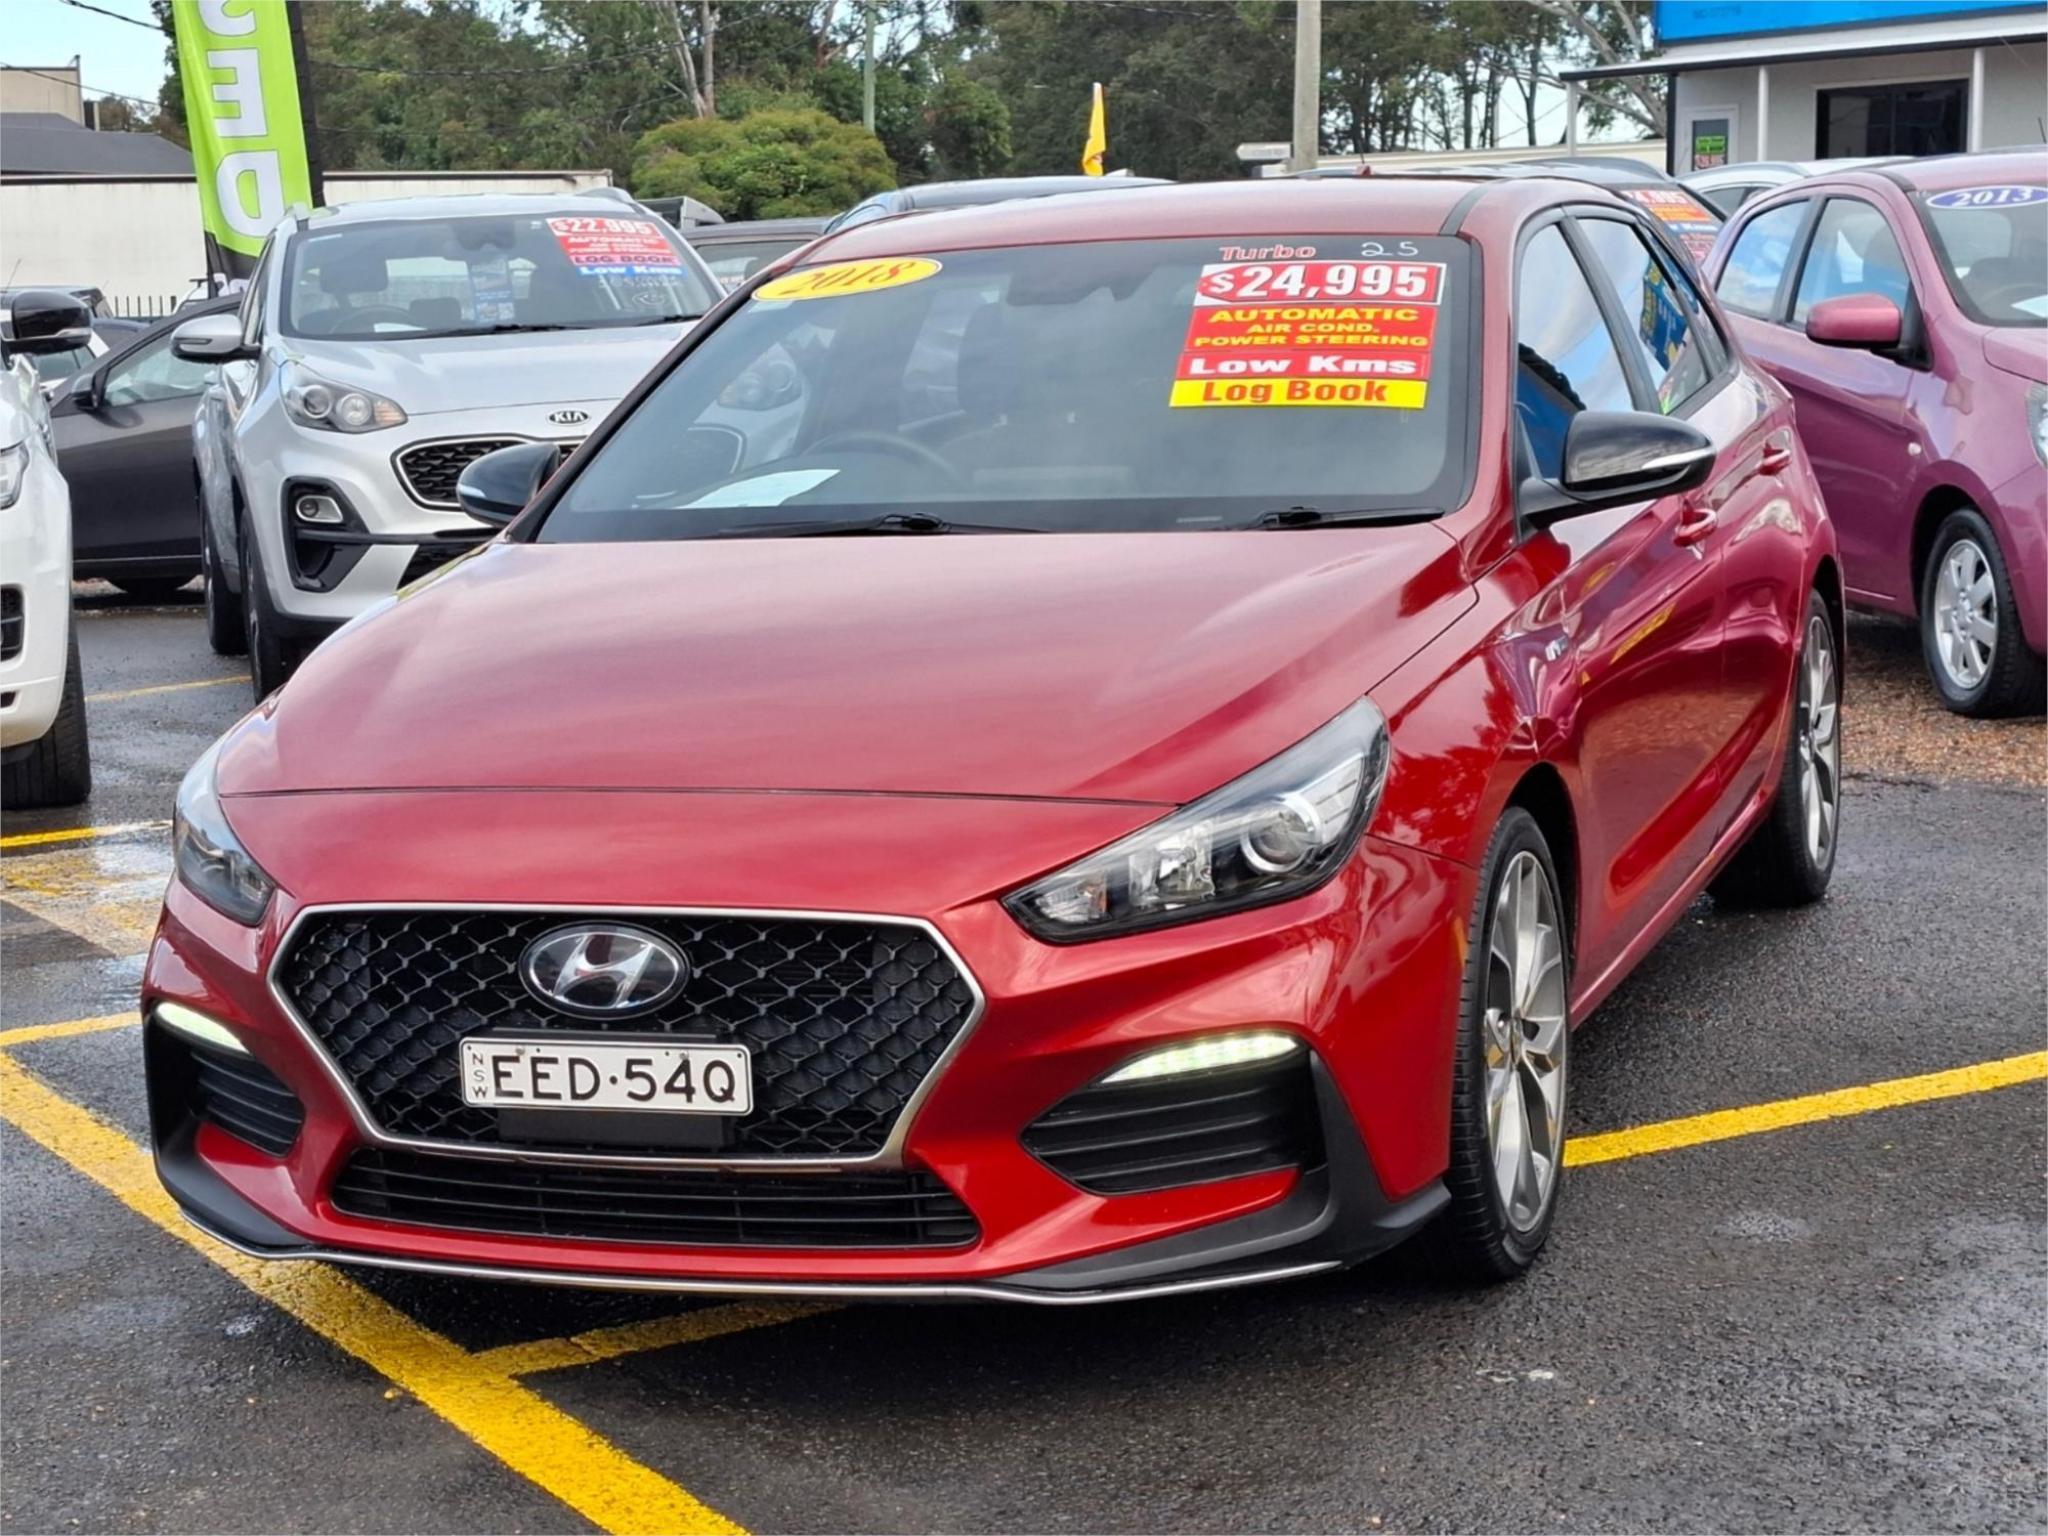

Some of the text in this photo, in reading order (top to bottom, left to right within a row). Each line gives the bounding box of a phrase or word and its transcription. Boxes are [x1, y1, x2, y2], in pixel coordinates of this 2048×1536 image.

[1951, 187, 2034, 208] 2013
[1218, 244, 1317, 261] Turbo
[777, 261, 917, 296] 2018
[1209, 264, 1428, 299] $24,995
[1207, 308, 1419, 322] AUTOMATIC
[1246, 322, 1380, 333] AIR COND.
[1194, 335, 1429, 347] POWER STEERING
[1189, 355, 1417, 374] Low Kms
[1202, 380, 1389, 404] Log Book
[554, 411, 585, 422] KIA
